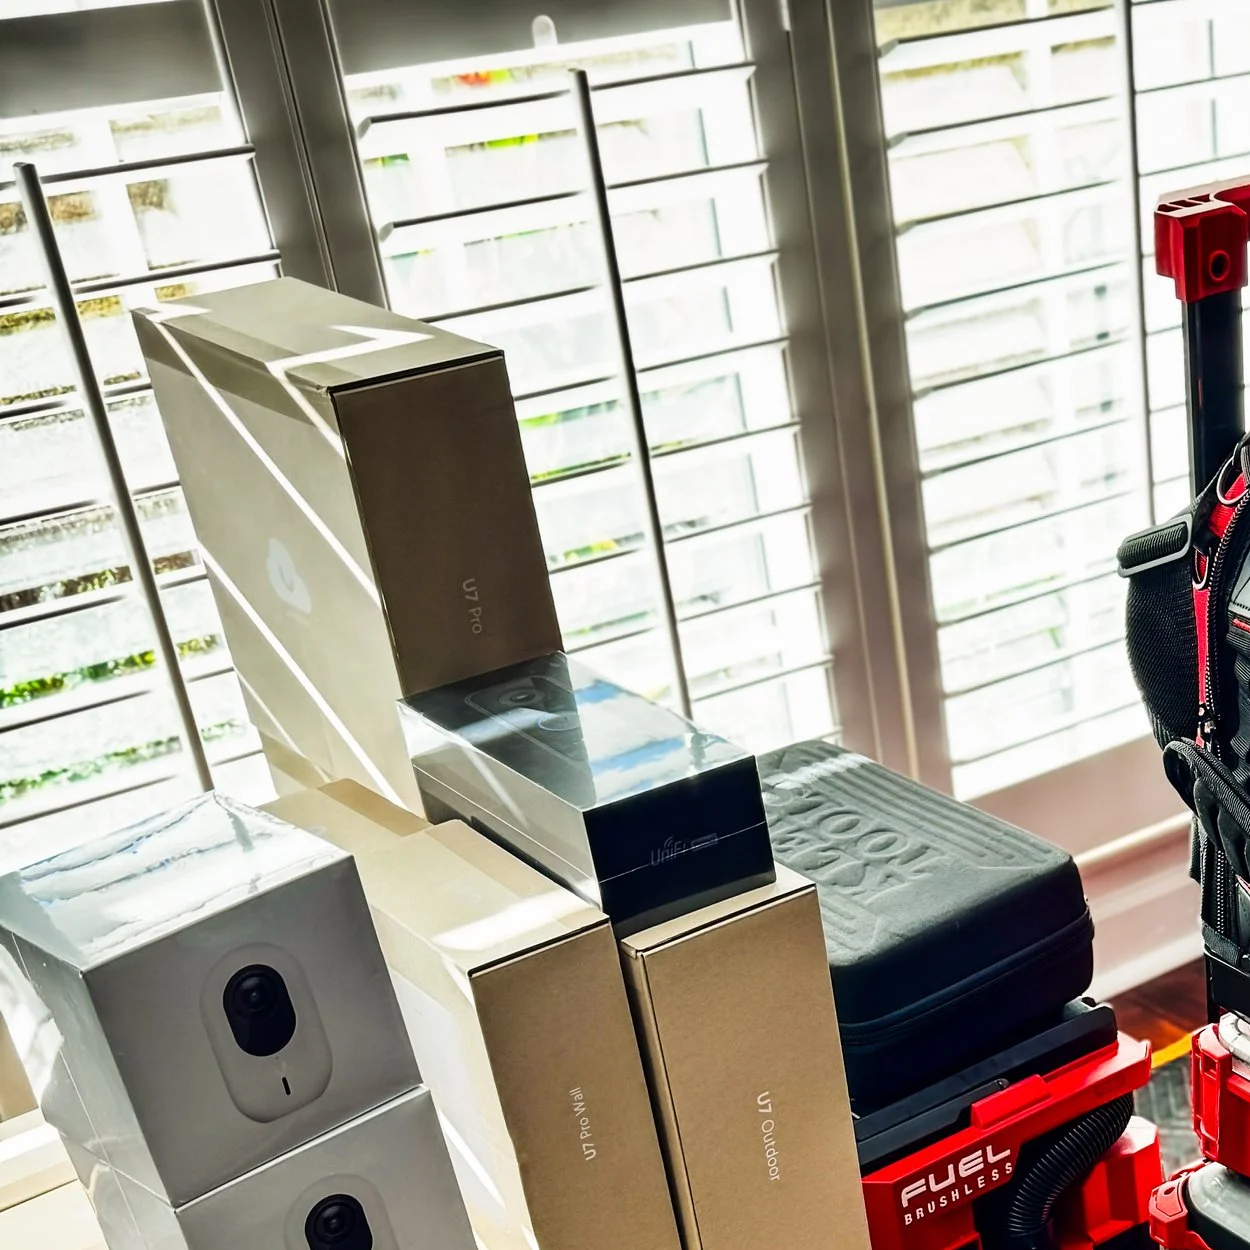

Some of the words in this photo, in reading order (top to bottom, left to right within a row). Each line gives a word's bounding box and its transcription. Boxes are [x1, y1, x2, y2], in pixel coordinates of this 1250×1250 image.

[463, 578, 479, 601] U7
[468, 606, 482, 634] Pro
[568, 1086, 586, 1117] Wall
[757, 1091, 772, 1113] U7
[580, 1117, 592, 1140] Pro
[582, 1143, 597, 1161] U7
[761, 1119, 781, 1181] Outdoor
[901, 1145, 1011, 1208] FUEL
[904, 1163, 1013, 1226] BRUSHLESS
